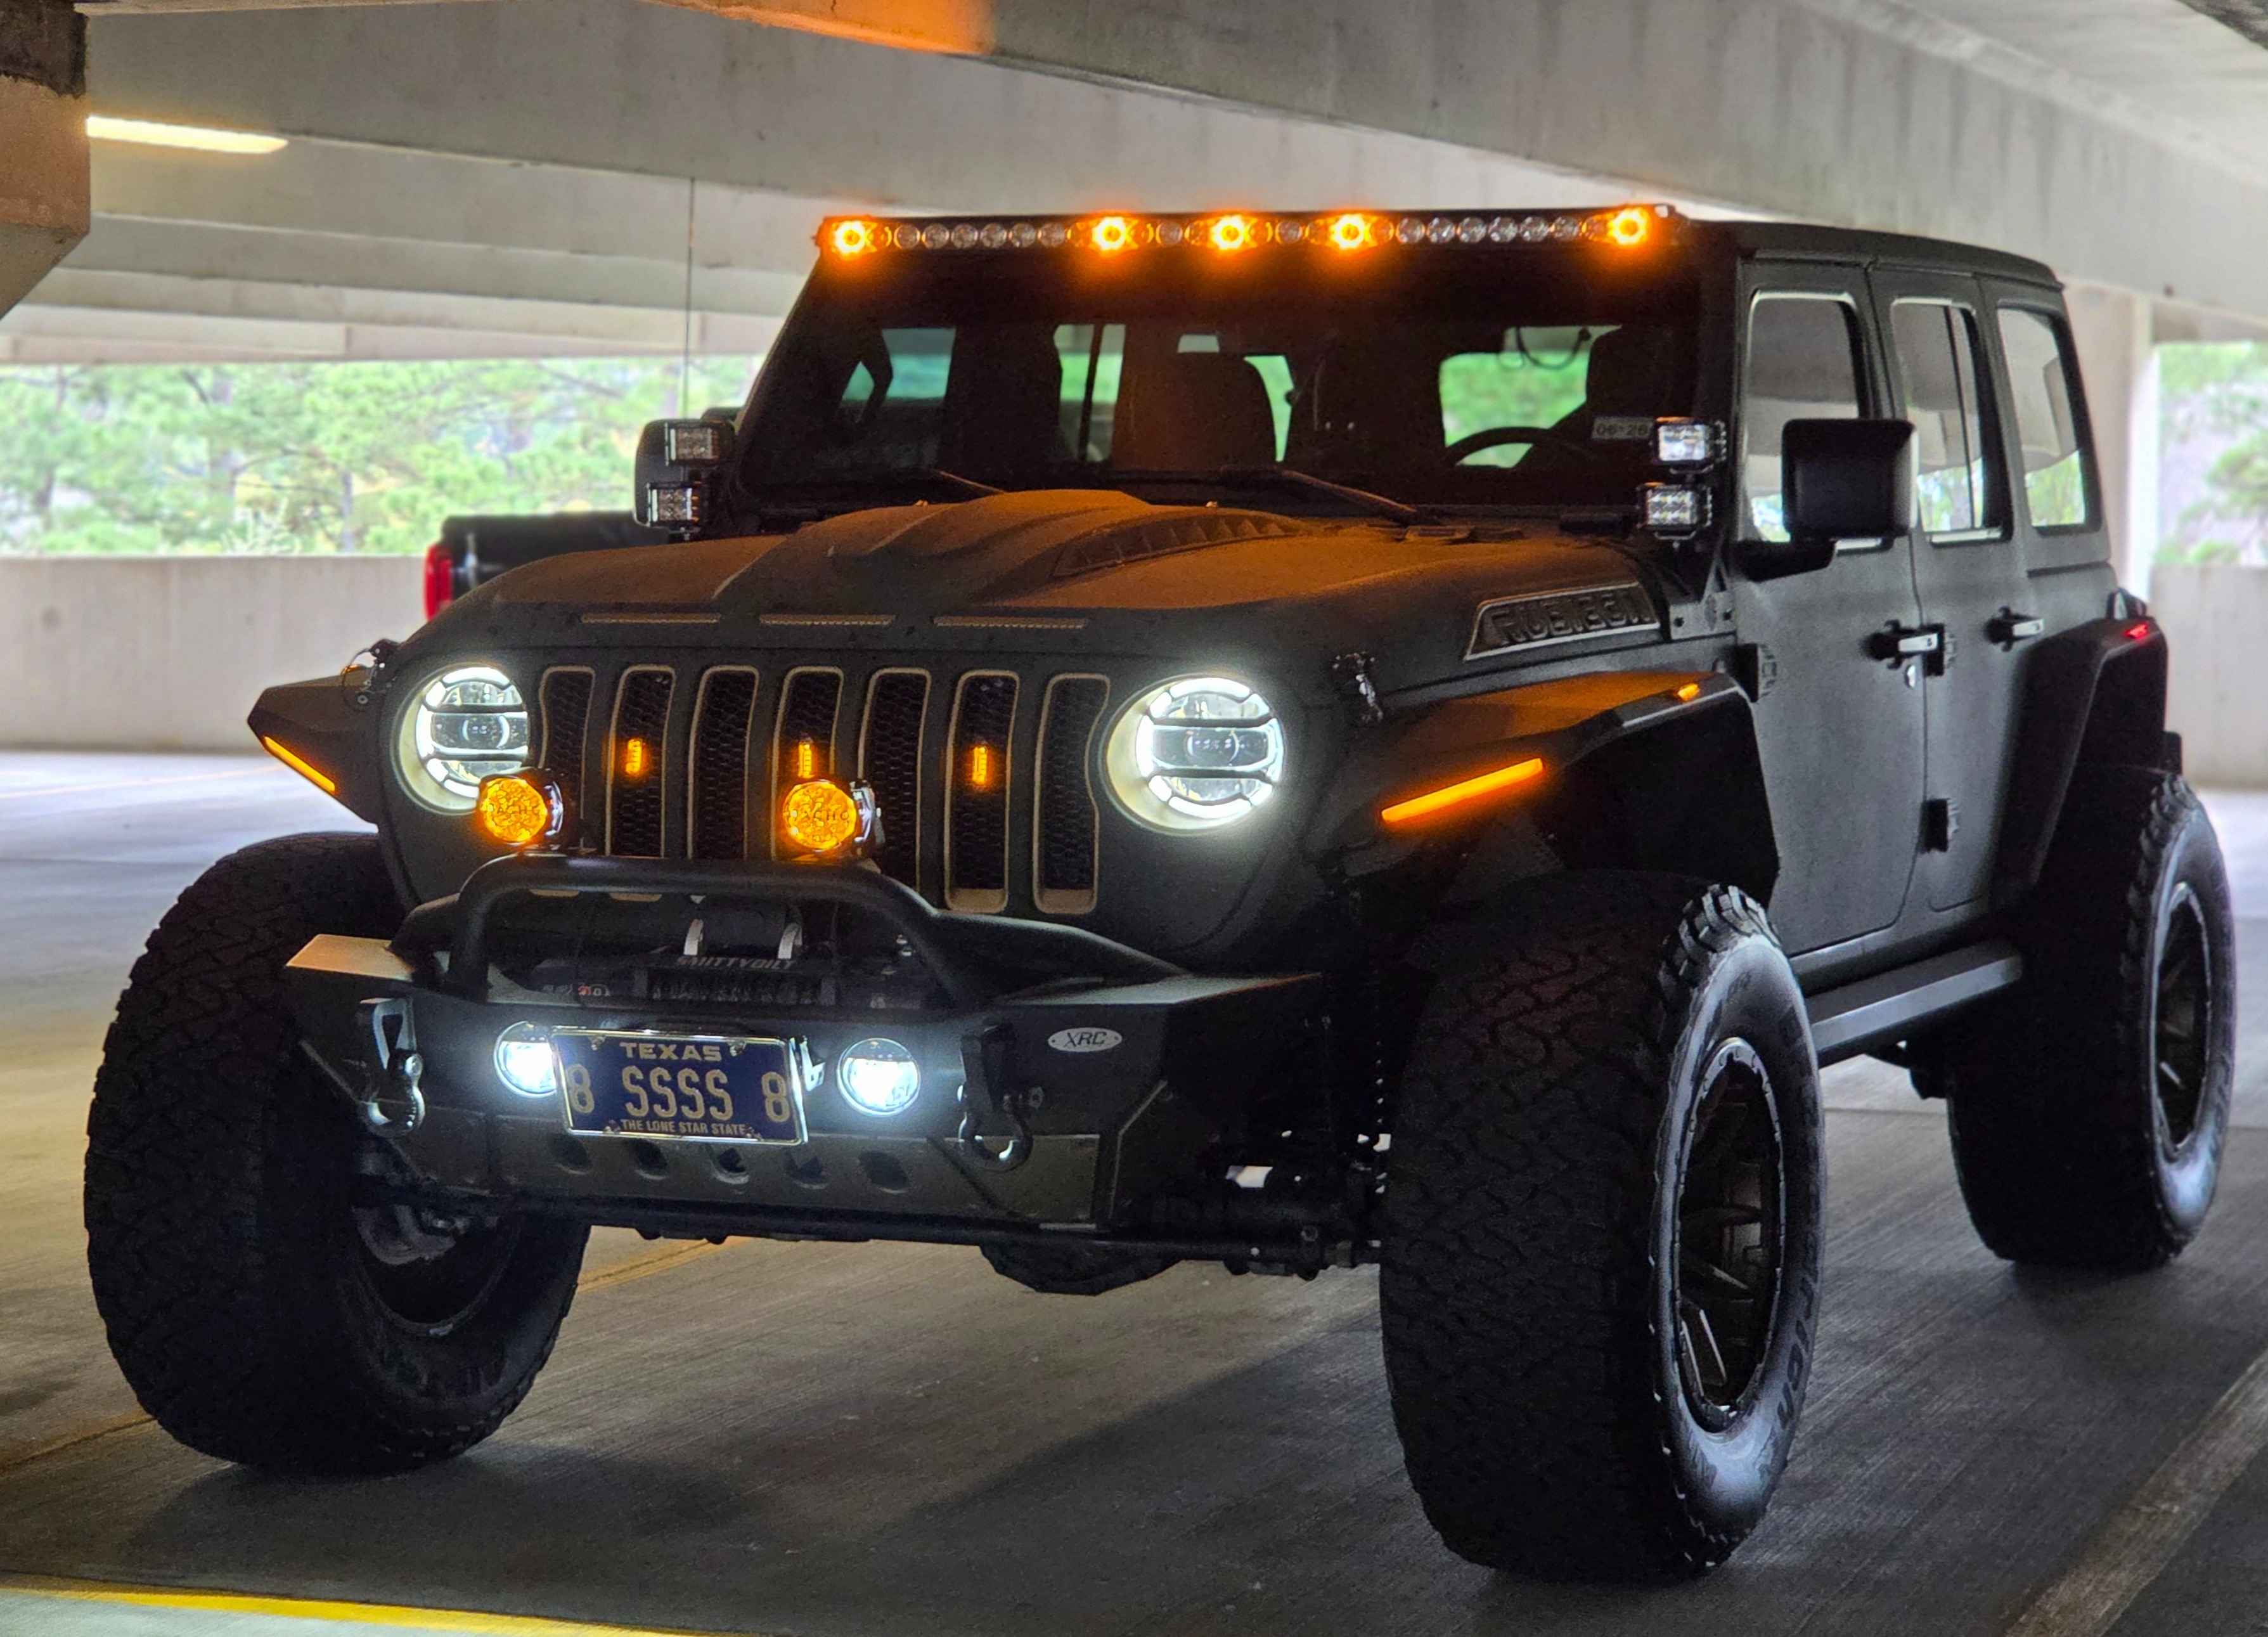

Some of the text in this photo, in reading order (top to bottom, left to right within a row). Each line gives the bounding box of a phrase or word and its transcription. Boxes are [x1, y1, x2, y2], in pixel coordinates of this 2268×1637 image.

[1063, 1031, 1107, 1048] XRC
[619, 1042, 723, 1062] TEXAS
[568, 1063, 791, 1123] 8 SSSS 8
[621, 1119, 747, 1136] THE LONE STAR STATE
